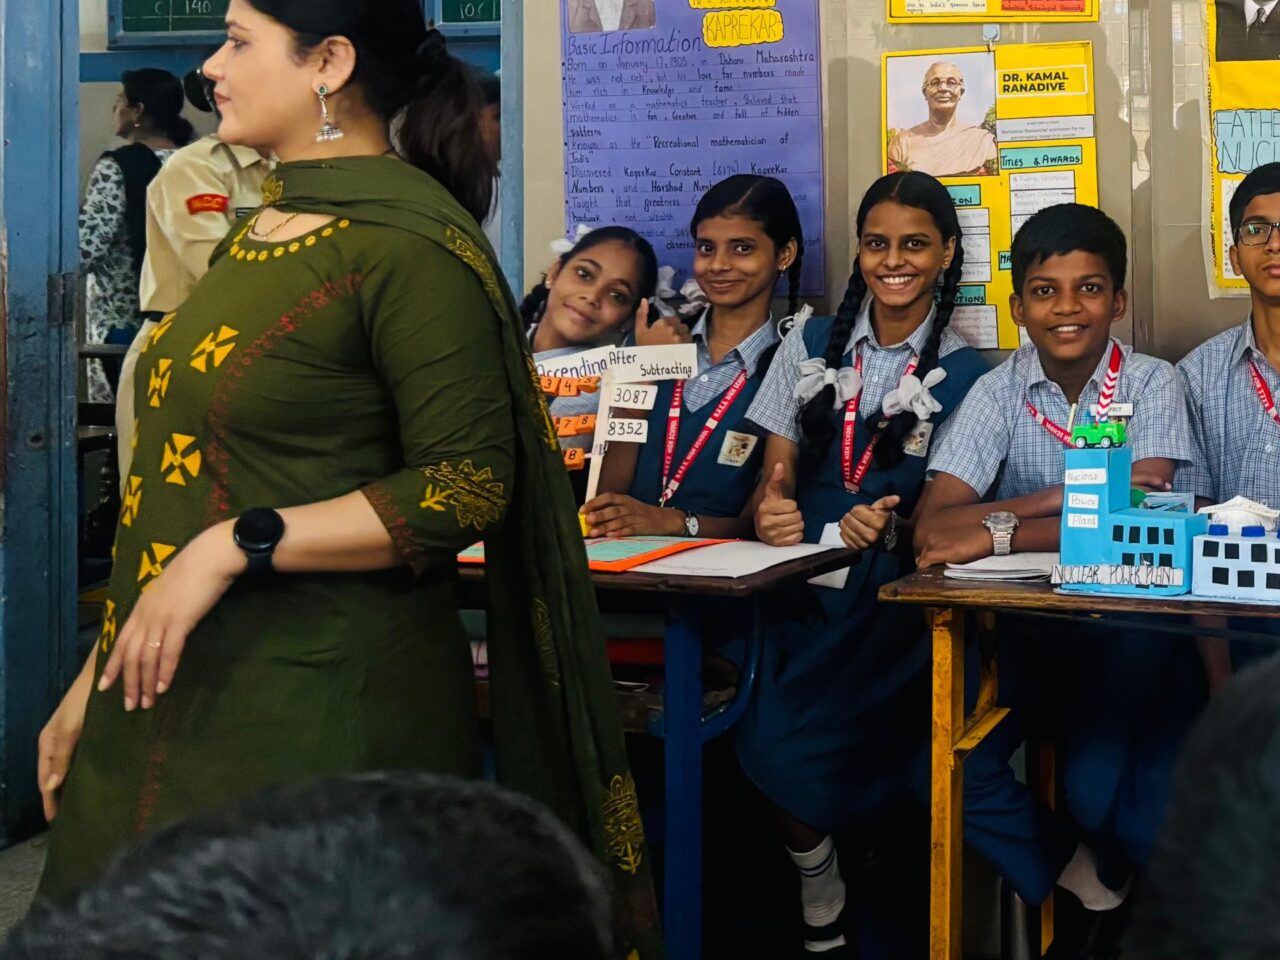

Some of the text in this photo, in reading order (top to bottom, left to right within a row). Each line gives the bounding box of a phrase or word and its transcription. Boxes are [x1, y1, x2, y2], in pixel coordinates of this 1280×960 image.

[185, 0, 211, 14] 140
[705, 13, 781, 41] KAPREKAR
[568, 28, 701, 56] Basic Information
[567, 58, 587, 70] Born
[1003, 72, 1068, 82] DR. KAMAL
[1003, 83, 1065, 92] RANADIVE
[1042, 155, 1080, 164] AWARDS
[609, 350, 637, 365] After
[641, 363, 692, 379] Subtracting
[613, 388, 648, 405] 3087
[607, 422, 642, 436] 8352
[1070, 495, 1096, 507] Power
[1072, 515, 1097, 526] Plant
[1052, 565, 1178, 585] NUCLEAR POWER PLANT
